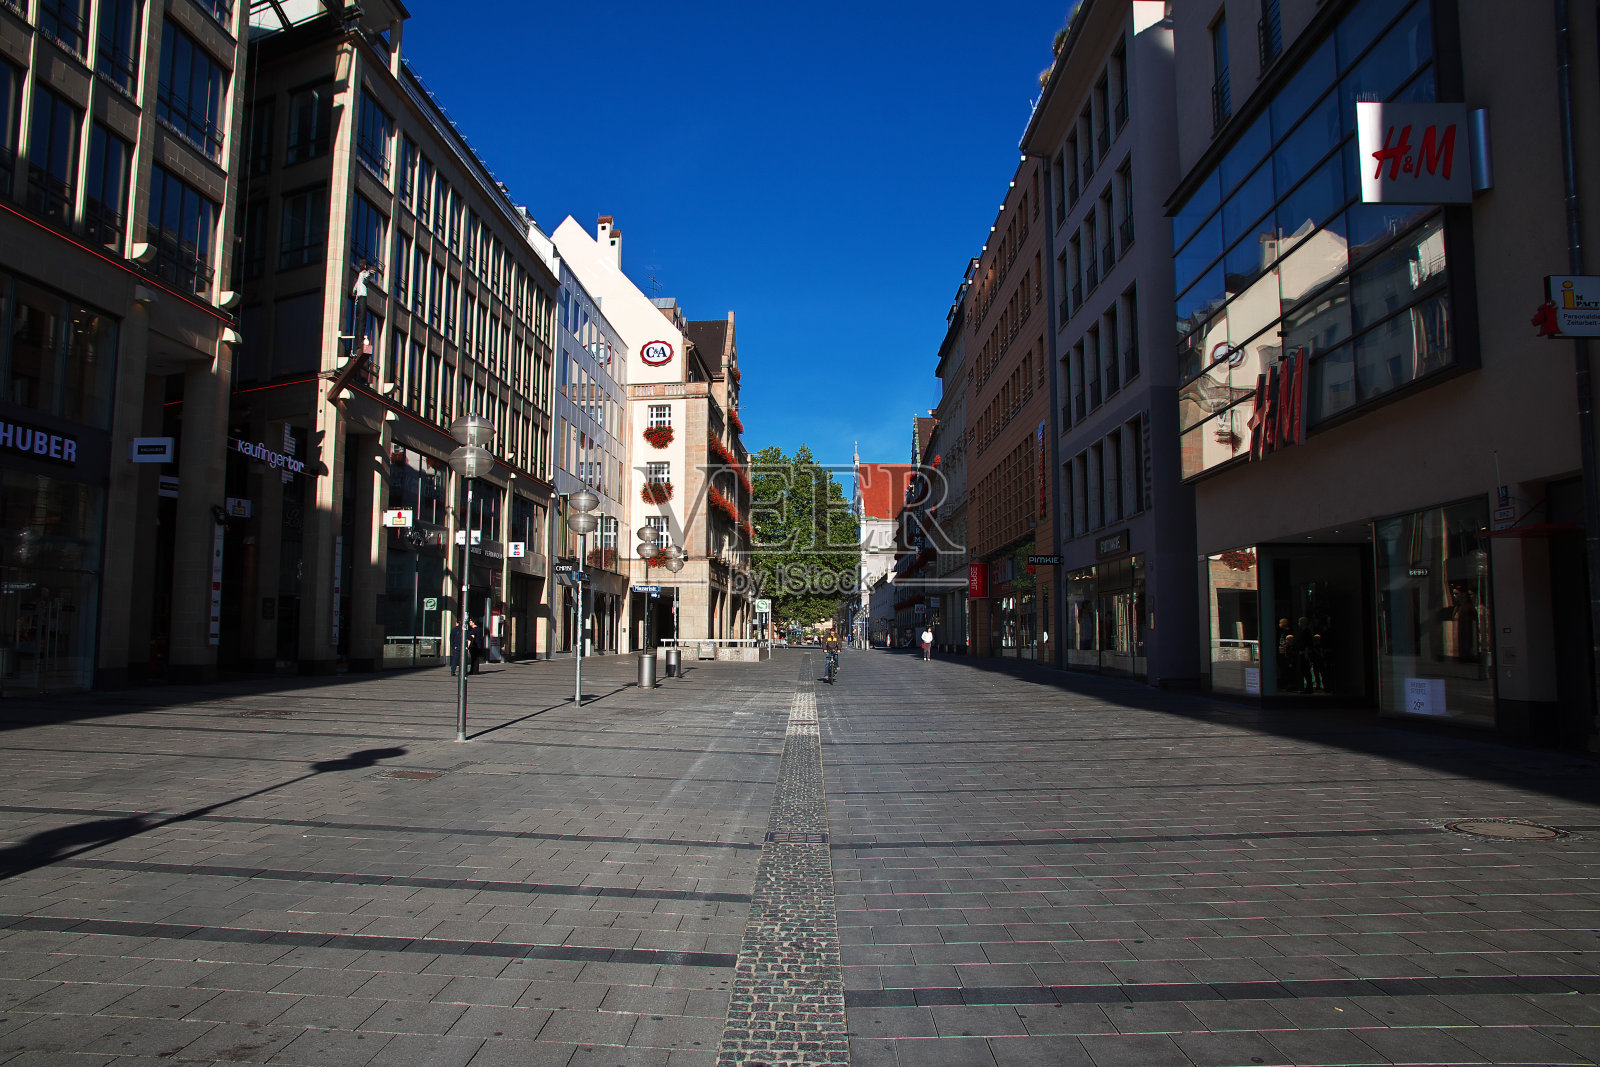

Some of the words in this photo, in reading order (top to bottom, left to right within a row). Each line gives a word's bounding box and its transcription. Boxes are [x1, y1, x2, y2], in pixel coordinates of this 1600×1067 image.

[1372, 124, 1457, 181] H&M
[646, 346, 668, 358] C&A
[1247, 347, 1309, 462] H&M
[0, 421, 78, 463] HUBER
[1028, 556, 1060, 564] PIMKIE
[970, 566, 978, 591] ESPRIT
